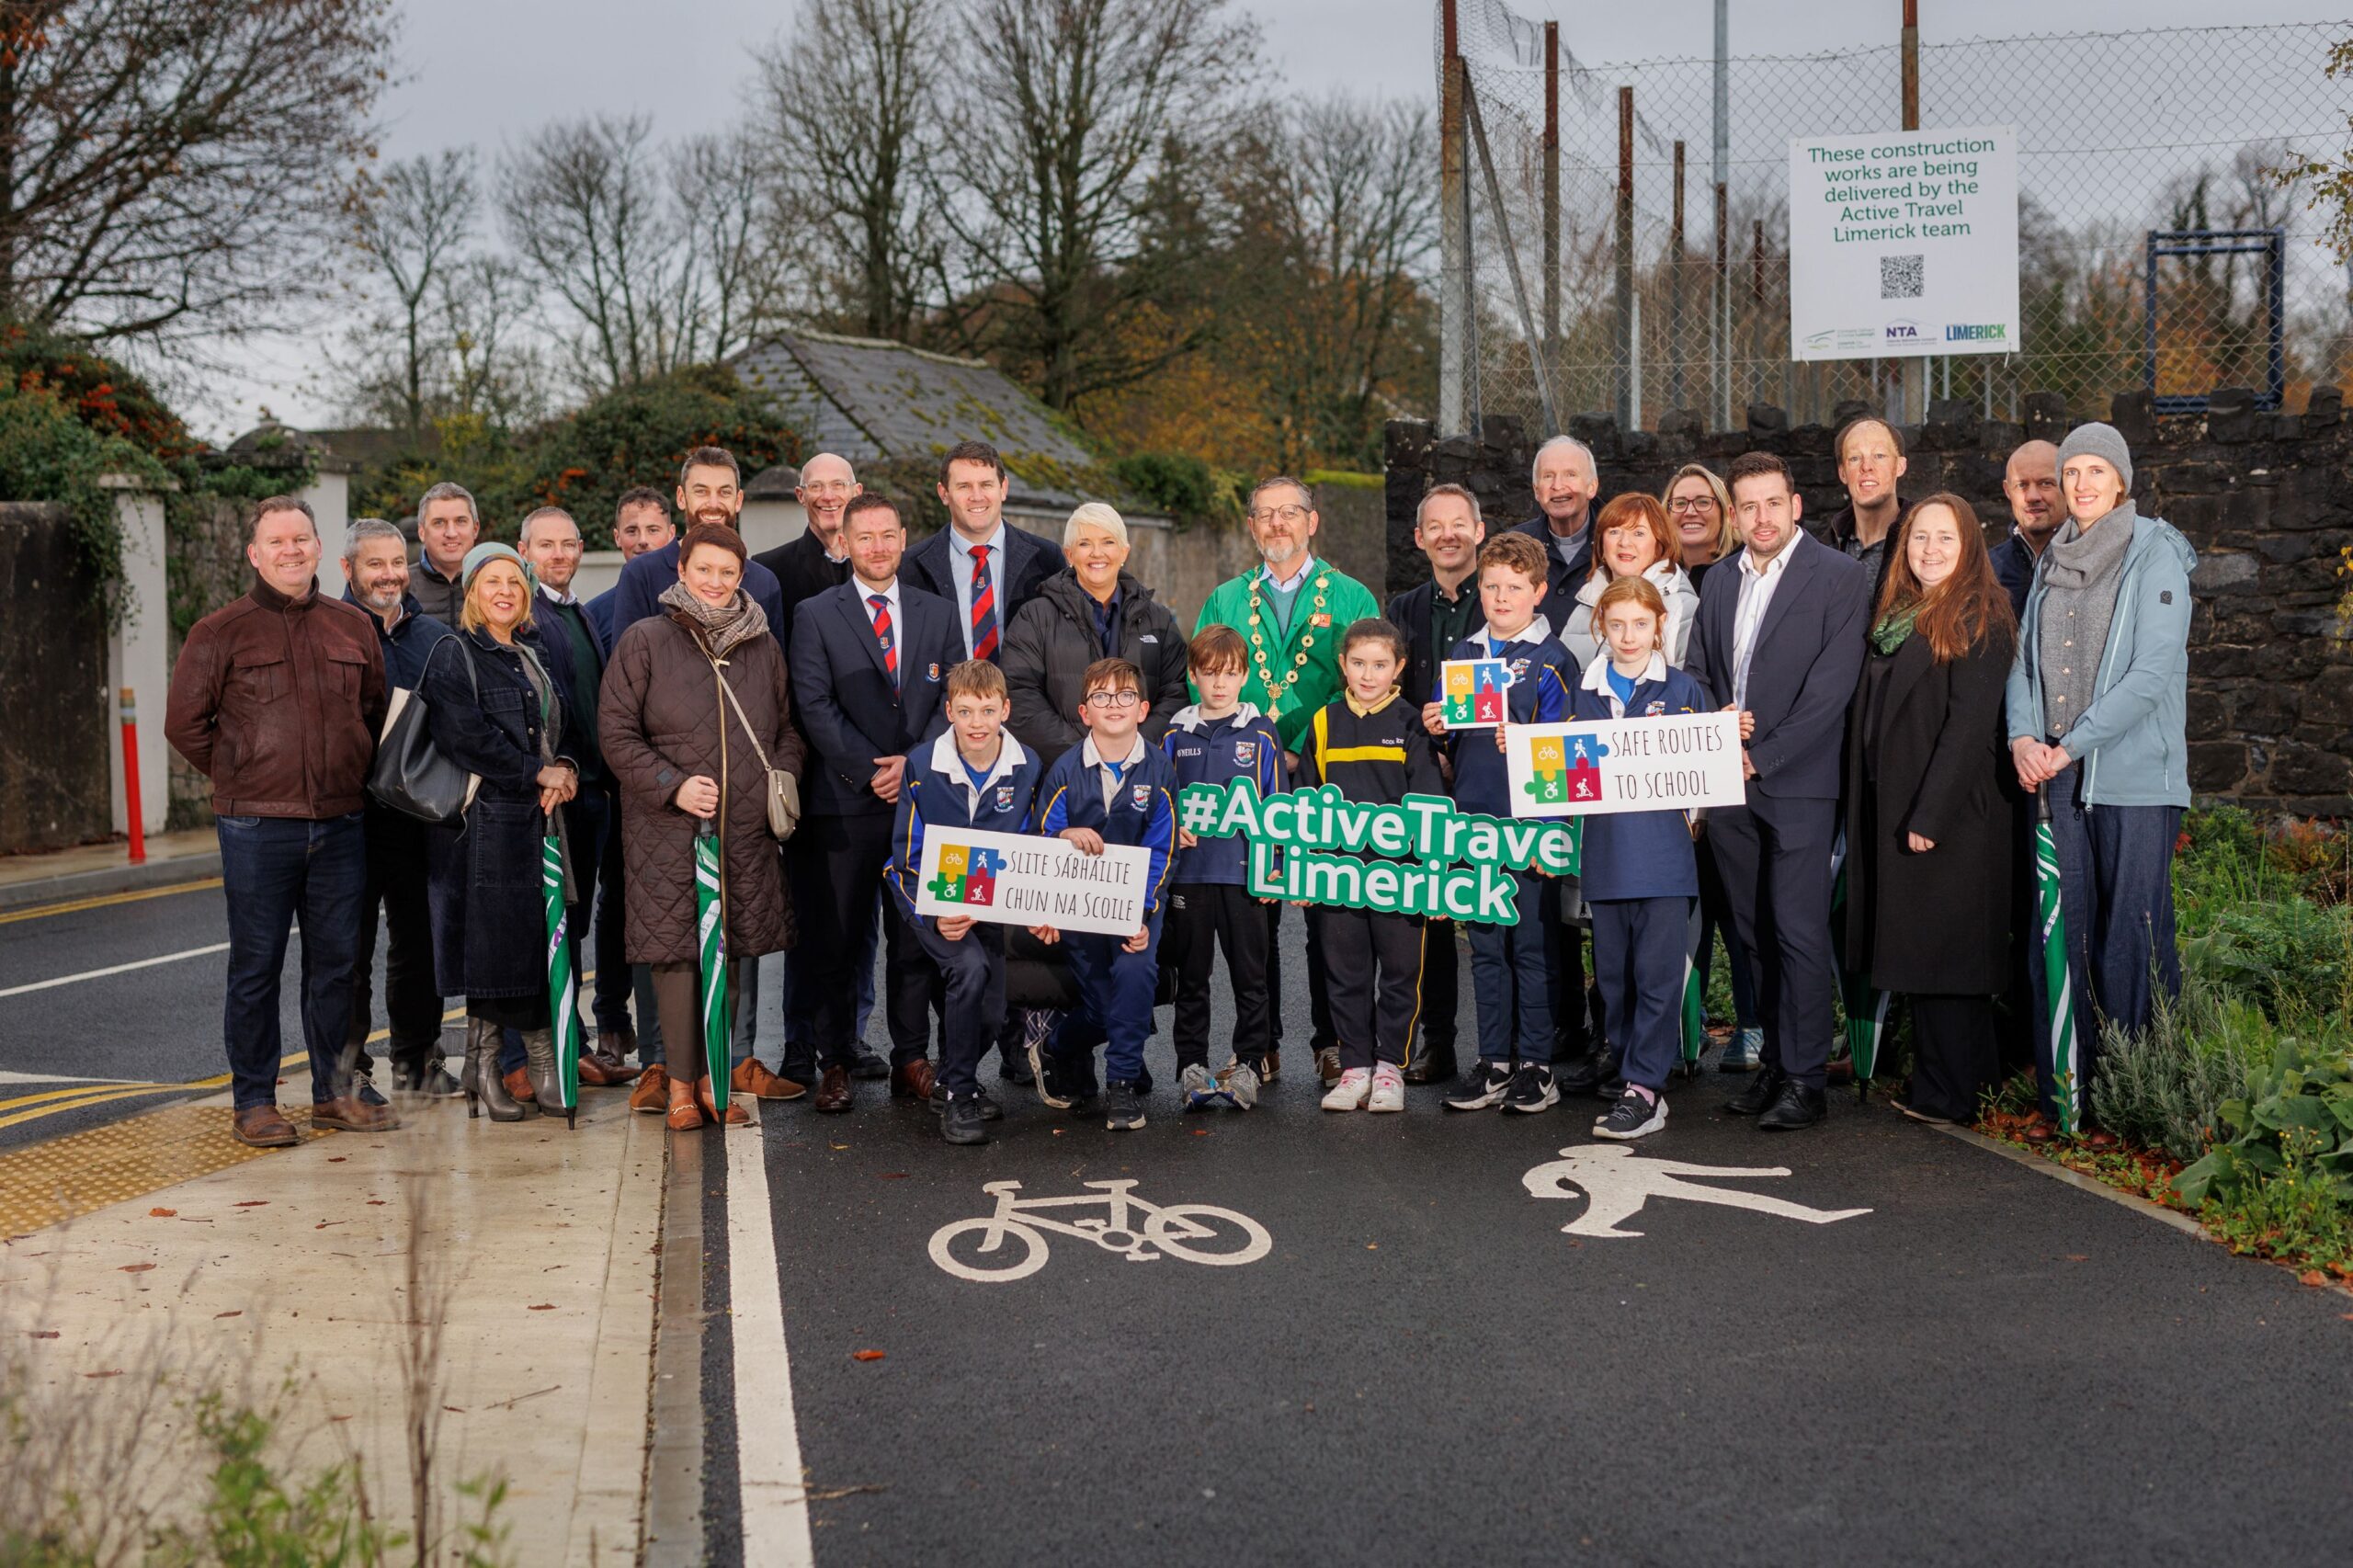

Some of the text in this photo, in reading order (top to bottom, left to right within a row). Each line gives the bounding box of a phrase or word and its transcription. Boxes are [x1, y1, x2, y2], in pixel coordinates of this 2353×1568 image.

[1808, 138, 1995, 163] These construction
[1824, 160, 1979, 182] works are being
[1824, 179, 1979, 202] delivered by the
[1840, 199, 1963, 222] Active Travel
[1834, 222, 1972, 243] Limerick team
[1886, 325, 1917, 337] NTA
[1946, 324, 2006, 341] LIMERICK
[1612, 725, 1723, 758] SAFE ROUTES
[1615, 770, 1711, 800] TO SCHOOL
[1182, 785, 1574, 869] #ActiveTrave
[1009, 850, 1131, 885] SLITE SÁBHÁILTE
[1255, 845, 1512, 918] Limerick
[1005, 887, 1134, 921] CHUN NA SCOILE
